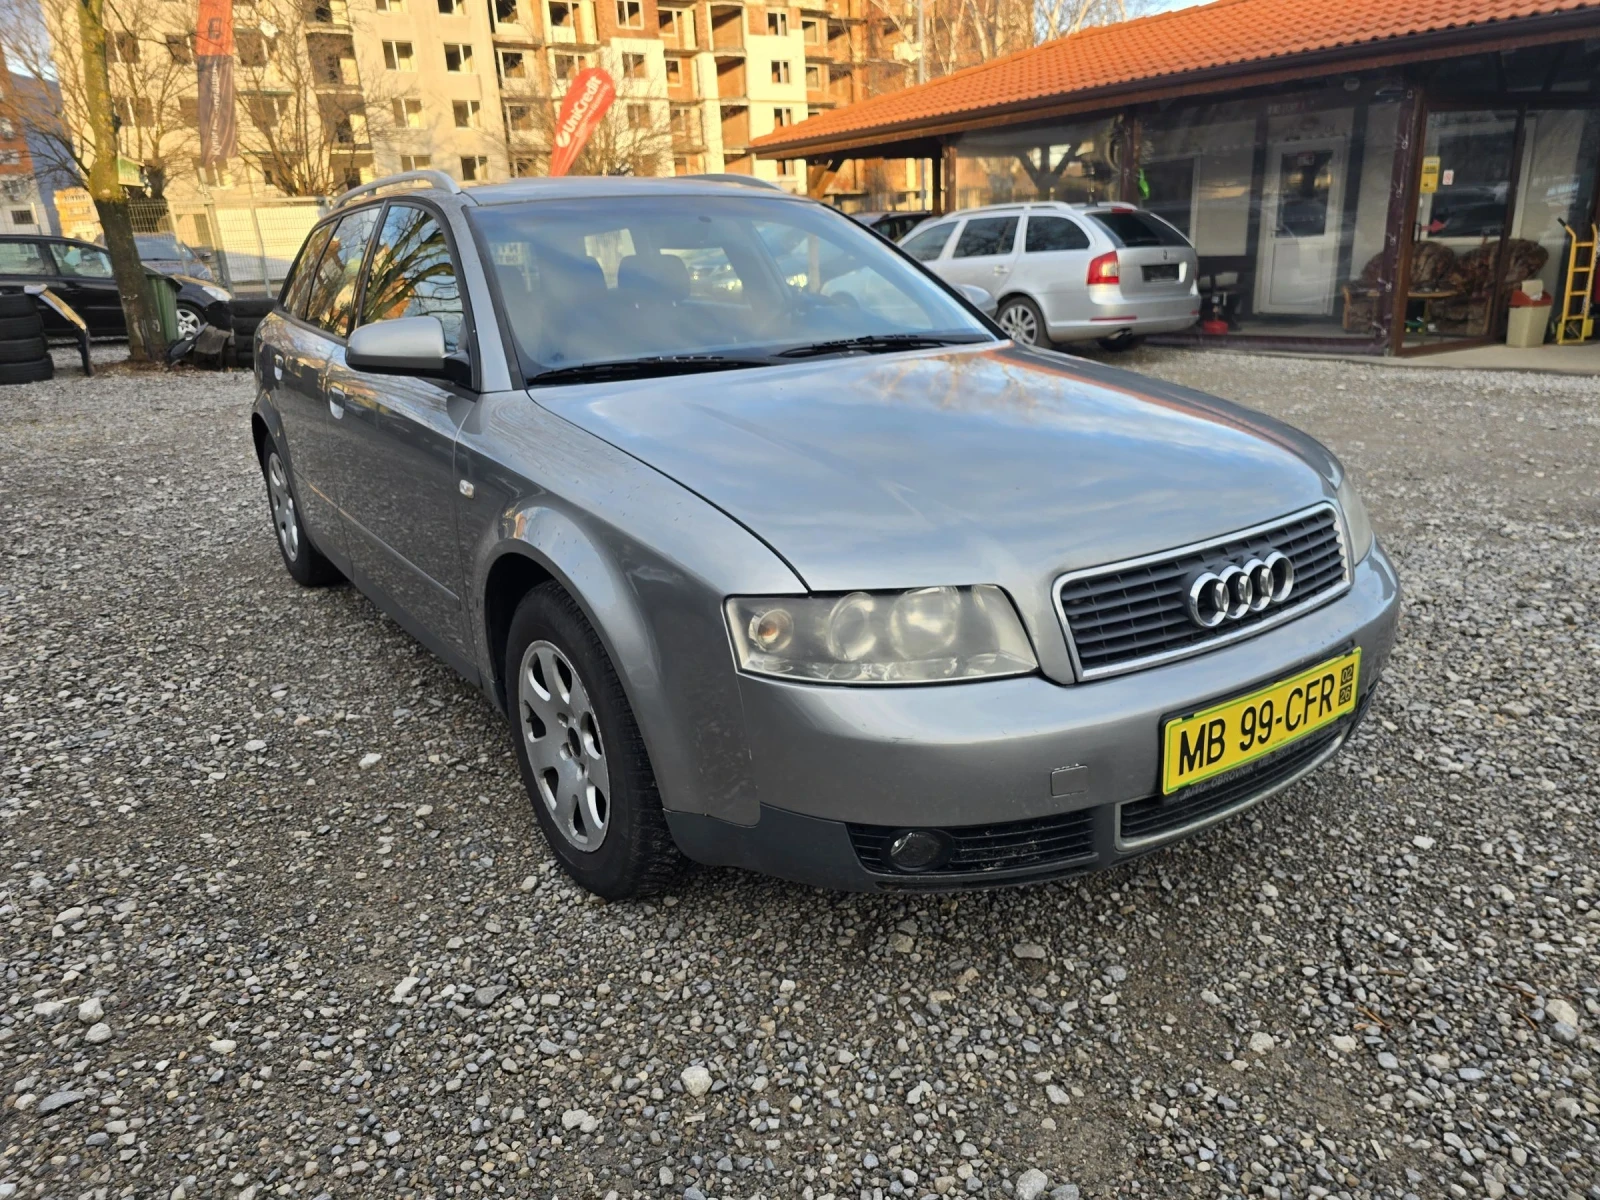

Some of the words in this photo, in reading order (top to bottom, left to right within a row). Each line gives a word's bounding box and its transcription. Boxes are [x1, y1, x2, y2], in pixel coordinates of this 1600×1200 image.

[562, 76, 602, 133] UniCredit
[1342, 666, 1353, 683] 02
[1340, 687, 1351, 703] 26
[1179, 718, 1226, 776] MB
[1239, 673, 1335, 752] 99-CFR
